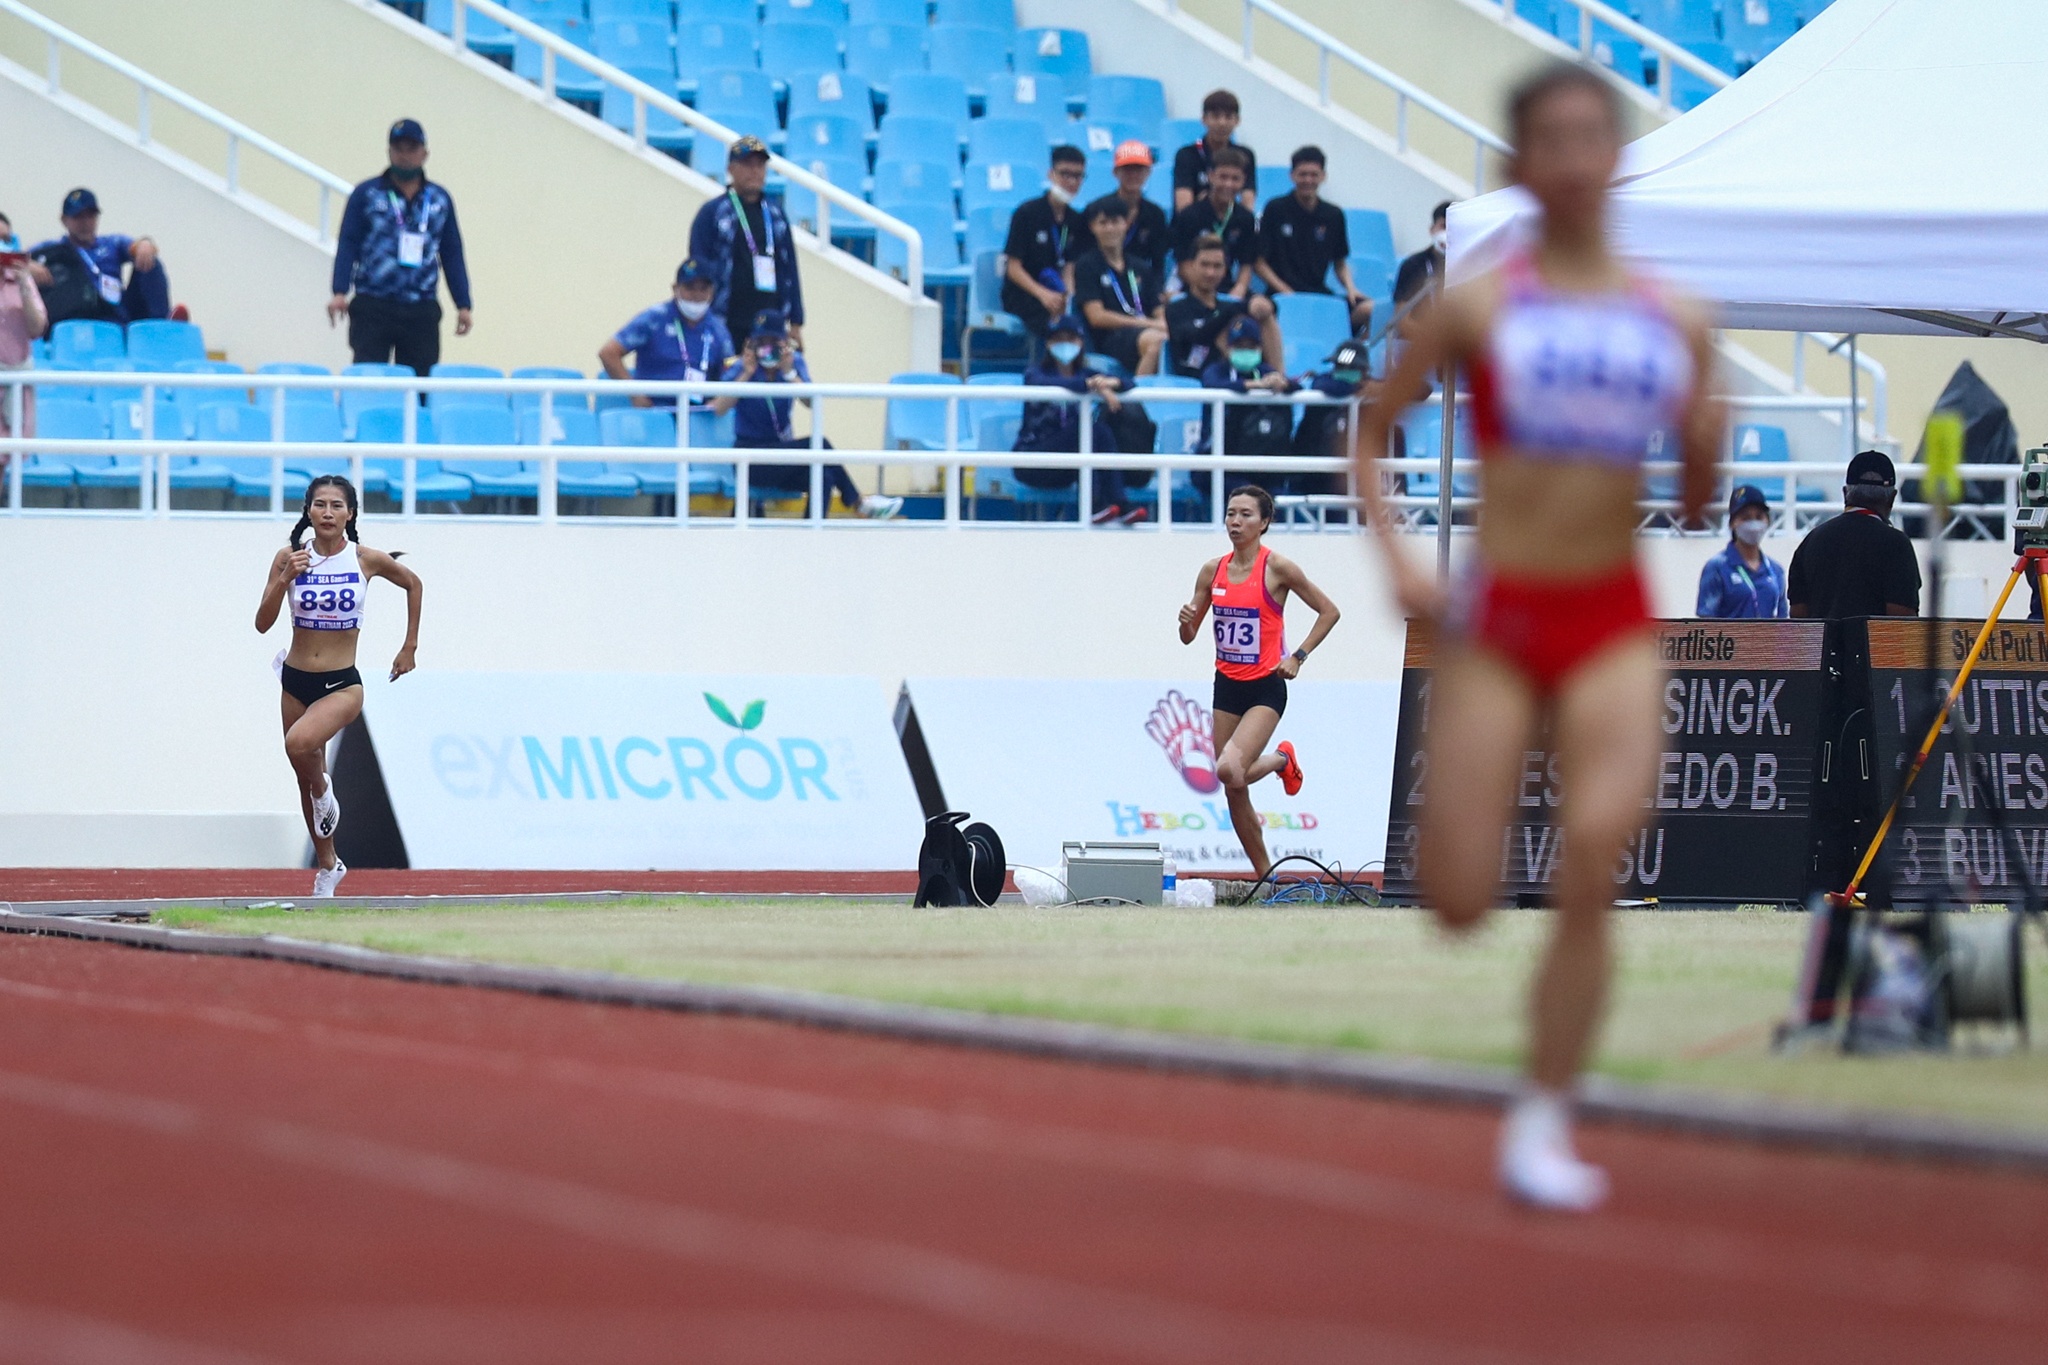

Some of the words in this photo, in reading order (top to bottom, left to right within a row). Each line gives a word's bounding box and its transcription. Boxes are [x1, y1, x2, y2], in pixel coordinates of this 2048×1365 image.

[318, 575, 330, 584] SEA
[330, 575, 349, 583] Games
[300, 588, 355, 612] 838
[1214, 620, 1254, 646] 613
[1655, 629, 1735, 661] tartliste
[2001, 630, 2033, 662] Put
[1661, 678, 1792, 736] SINGK.
[1890, 677, 1907, 734] 1
[1750, 753, 1787, 811] B.
[1902, 827, 1922, 885] 3
[1944, 828, 2008, 886] BUI
